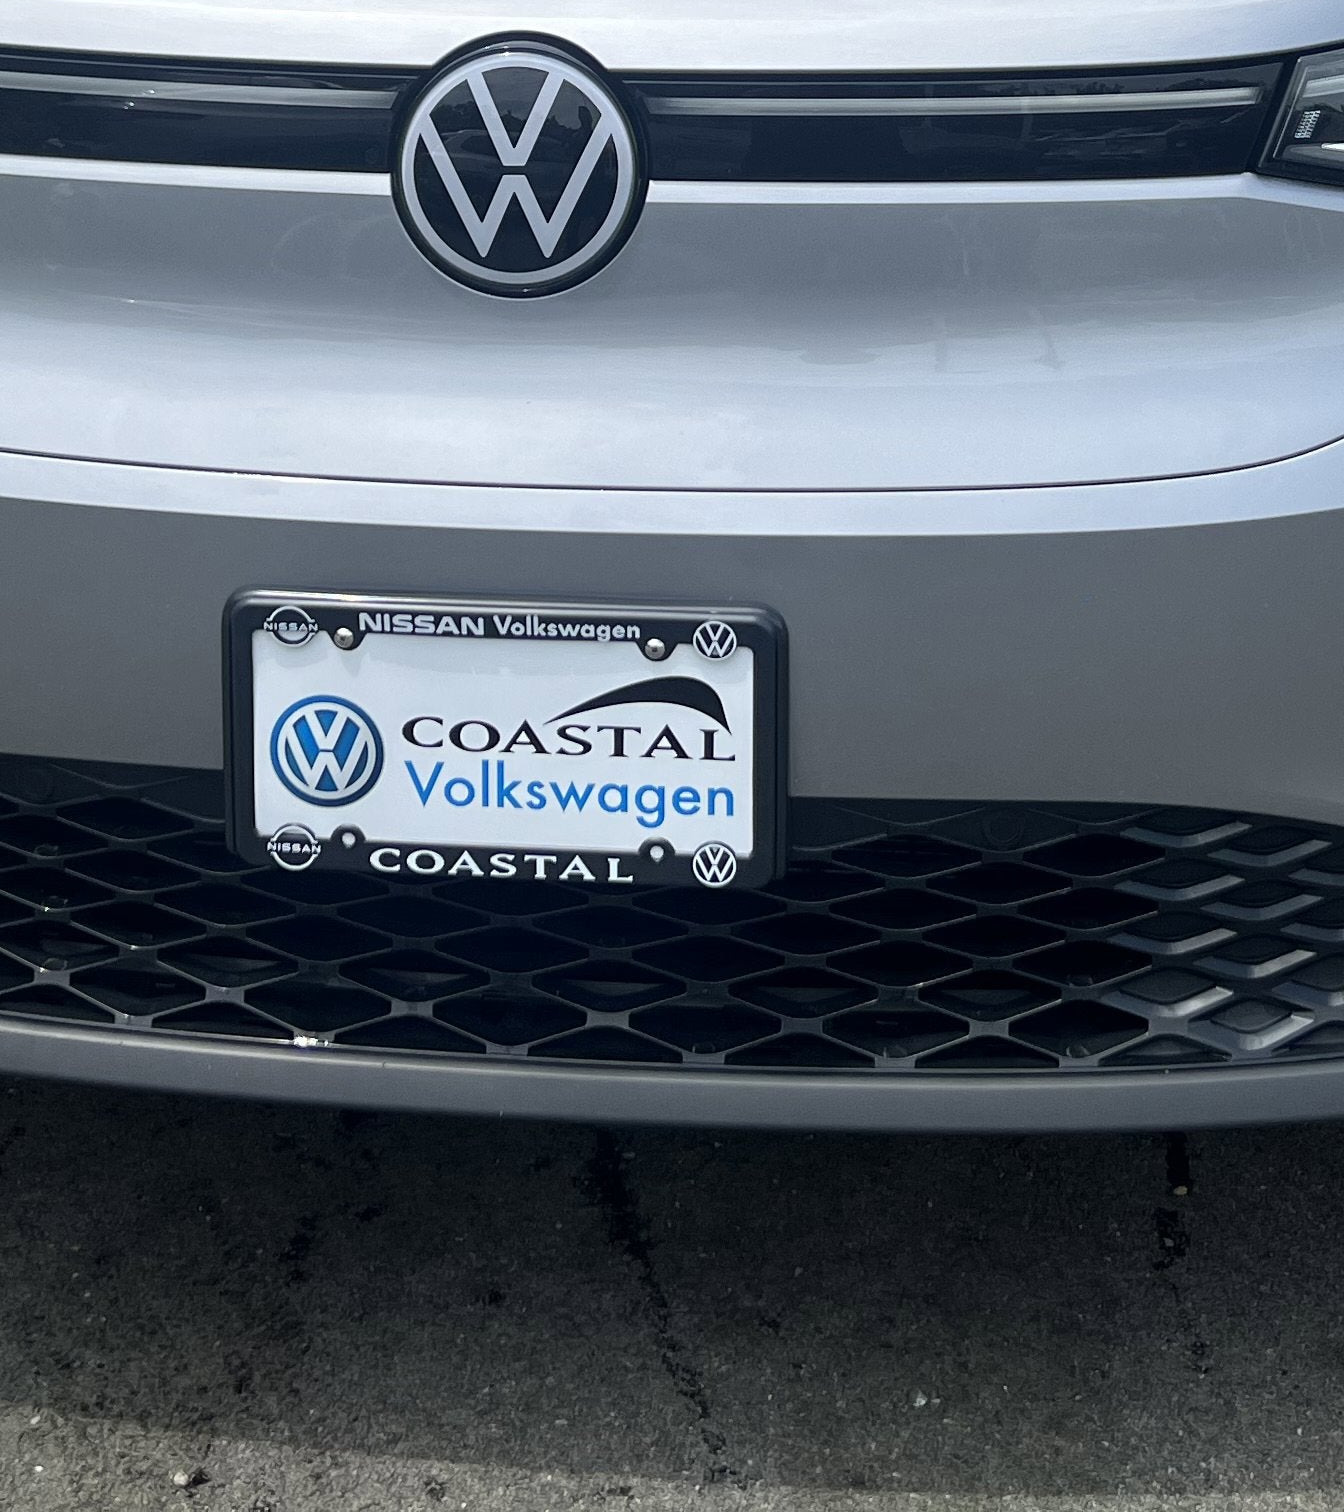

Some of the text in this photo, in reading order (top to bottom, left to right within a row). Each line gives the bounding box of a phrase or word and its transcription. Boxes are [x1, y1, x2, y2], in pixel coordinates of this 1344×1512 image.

[263, 621, 318, 632] NISSAN
[359, 612, 641, 643] NISSAN Volkswagen
[402, 716, 736, 762] COASTAL
[405, 760, 734, 828] Volkswagen
[267, 841, 322, 855] NISSAN
[369, 848, 635, 884] COASTAL
